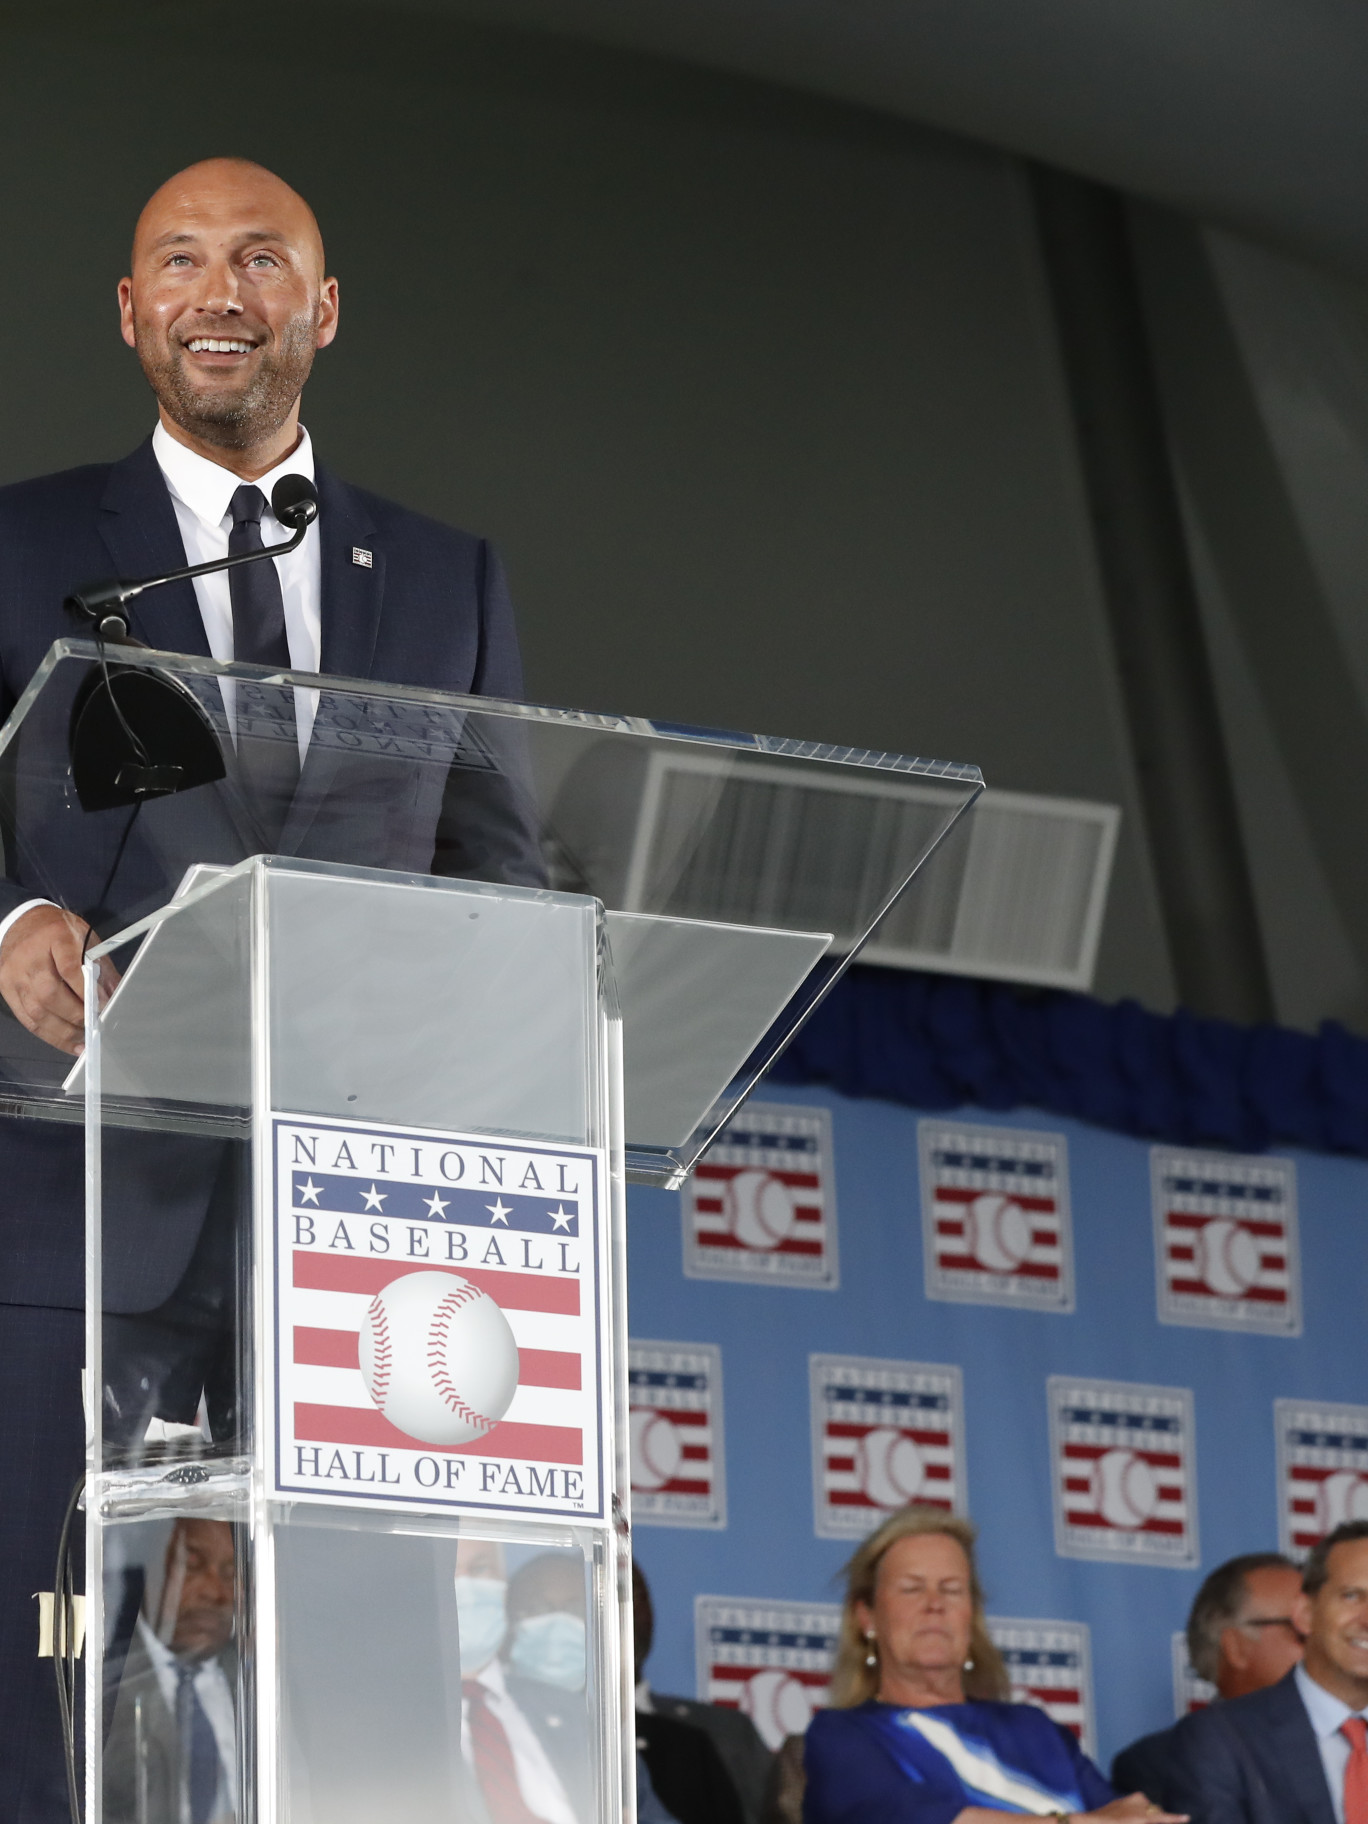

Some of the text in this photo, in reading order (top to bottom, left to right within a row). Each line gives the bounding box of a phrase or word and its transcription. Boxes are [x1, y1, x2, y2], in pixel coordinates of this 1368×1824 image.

[291, 1134, 579, 1194] NATIONAL
[292, 1214, 580, 1273] BASEBALL
[294, 1445, 584, 1500] HALL OF FAME
